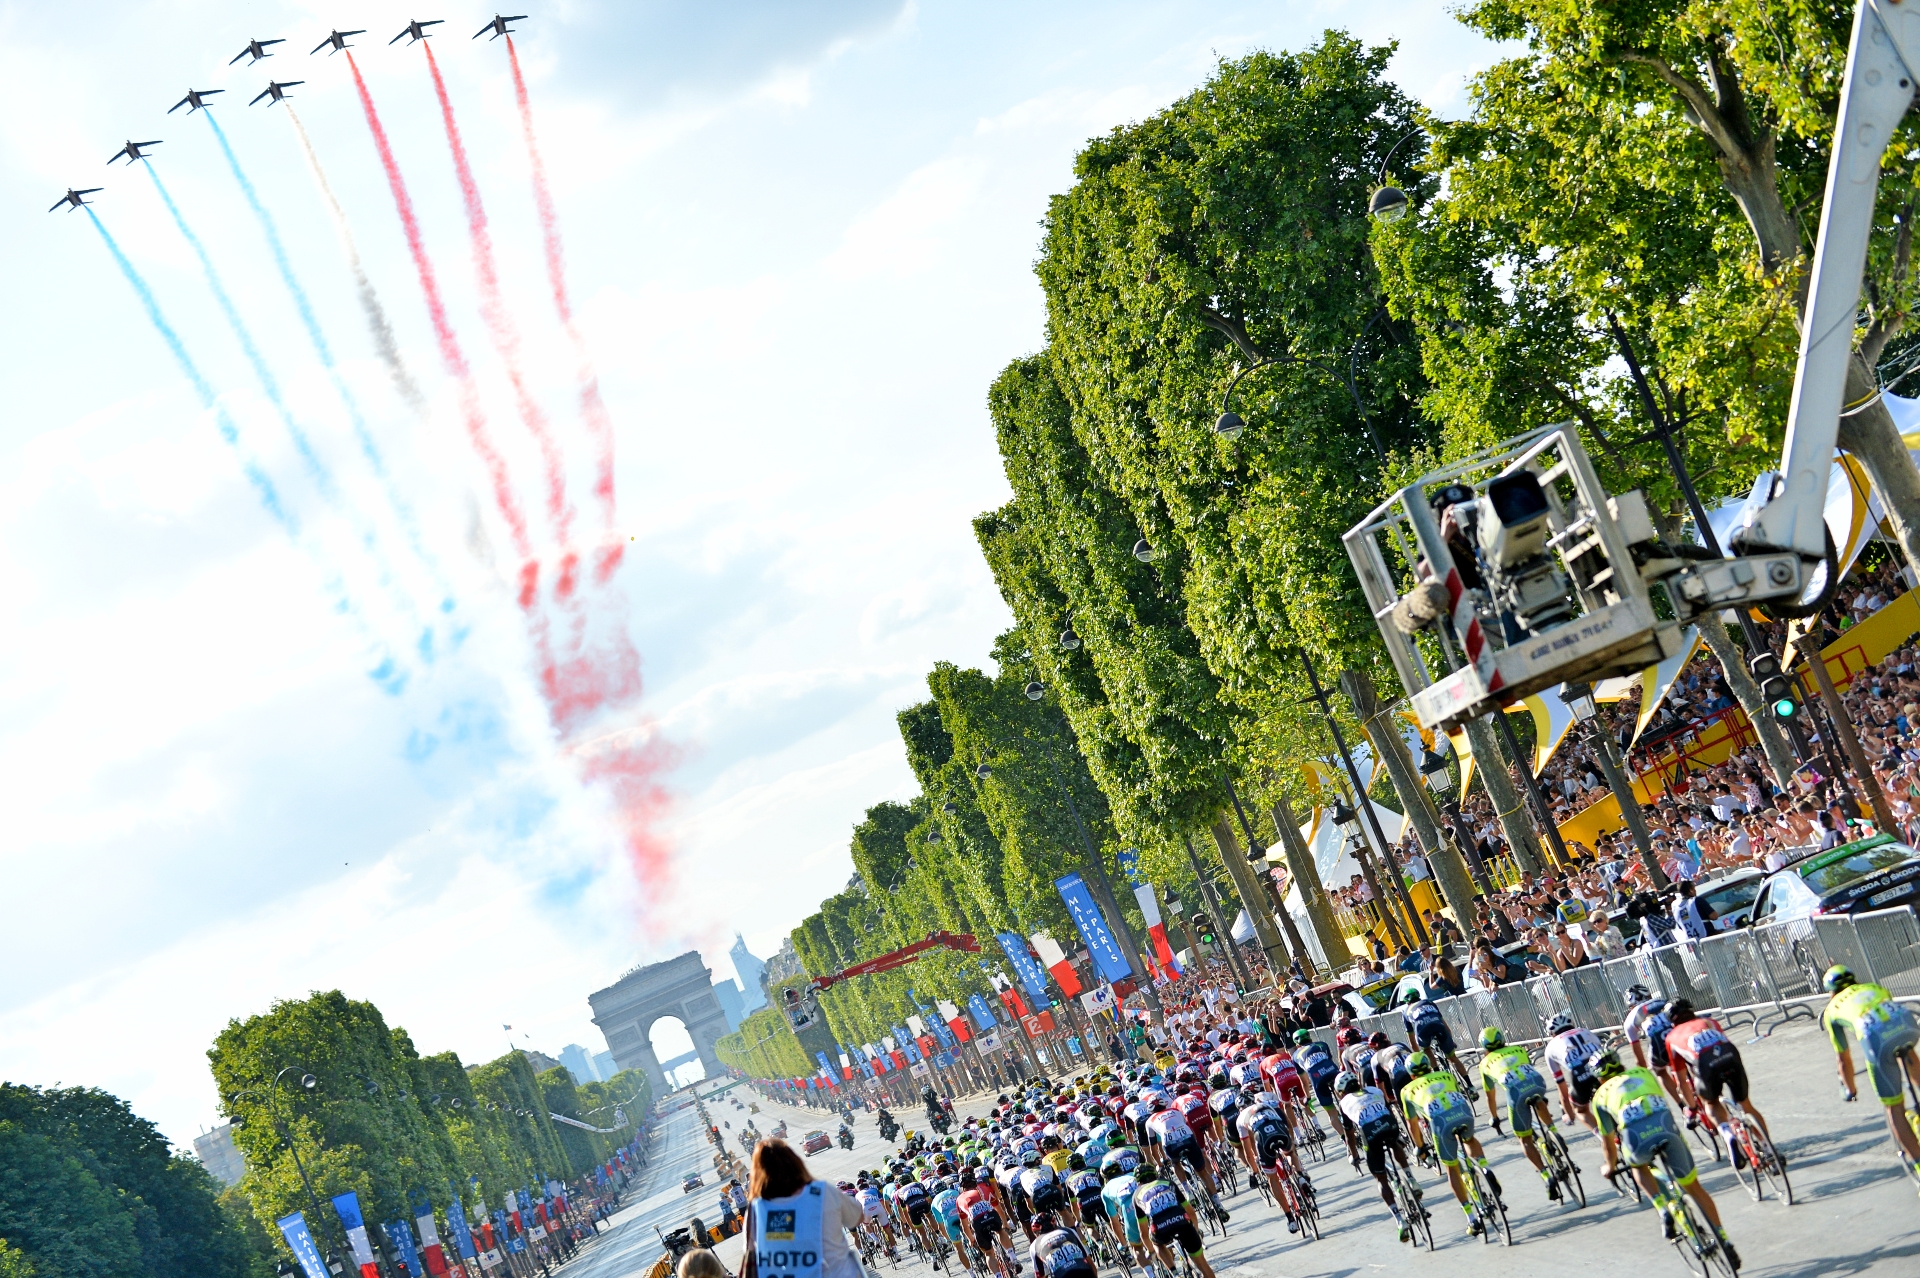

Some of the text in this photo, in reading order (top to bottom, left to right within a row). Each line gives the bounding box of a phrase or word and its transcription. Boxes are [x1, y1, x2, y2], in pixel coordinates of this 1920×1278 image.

[1817, 849, 1846, 865] ŠKODA
[1889, 865, 1920, 881] ŠKODA
[1848, 880, 1880, 897] ŠKODA
[1068, 896, 1099, 950] MAIRIE
[1684, 921, 1693, 930] TV
[1090, 917, 1118, 963] PARIS
[1002, 938, 1029, 983] MAIRIE
[1021, 957, 1045, 995] PARIS
[1177, 1127, 1187, 1137] 76
[758, 1250, 818, 1268] HOTO
